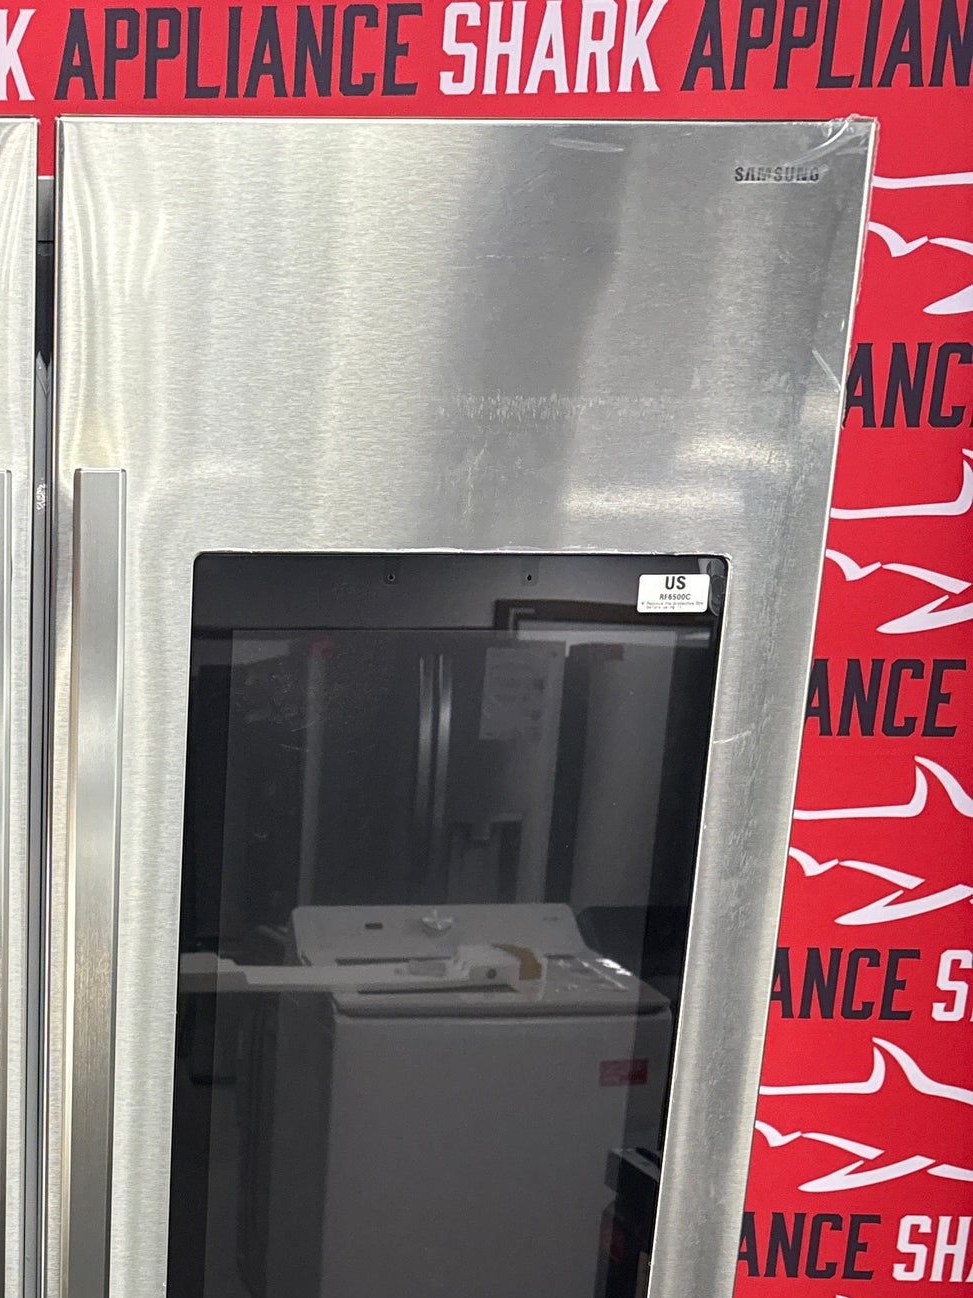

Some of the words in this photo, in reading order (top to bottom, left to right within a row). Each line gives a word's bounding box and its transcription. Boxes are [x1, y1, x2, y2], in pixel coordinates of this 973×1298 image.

[55, 3, 422, 99] APPLIANCE
[440, 0, 662, 95] SHARK
[681, 0, 973, 90] APPLIAN
[734, 166, 820, 182] SAMSUNG
[845, 342, 973, 427] ANC
[659, 593, 691, 601] RF6500C
[665, 575, 686, 590] US
[805, 659, 966, 737] ANCE
[770, 946, 920, 1020] ANCE
[932, 950, 973, 1021] S
[737, 1211, 881, 1280] ANCE
[893, 1216, 973, 1282] SH
